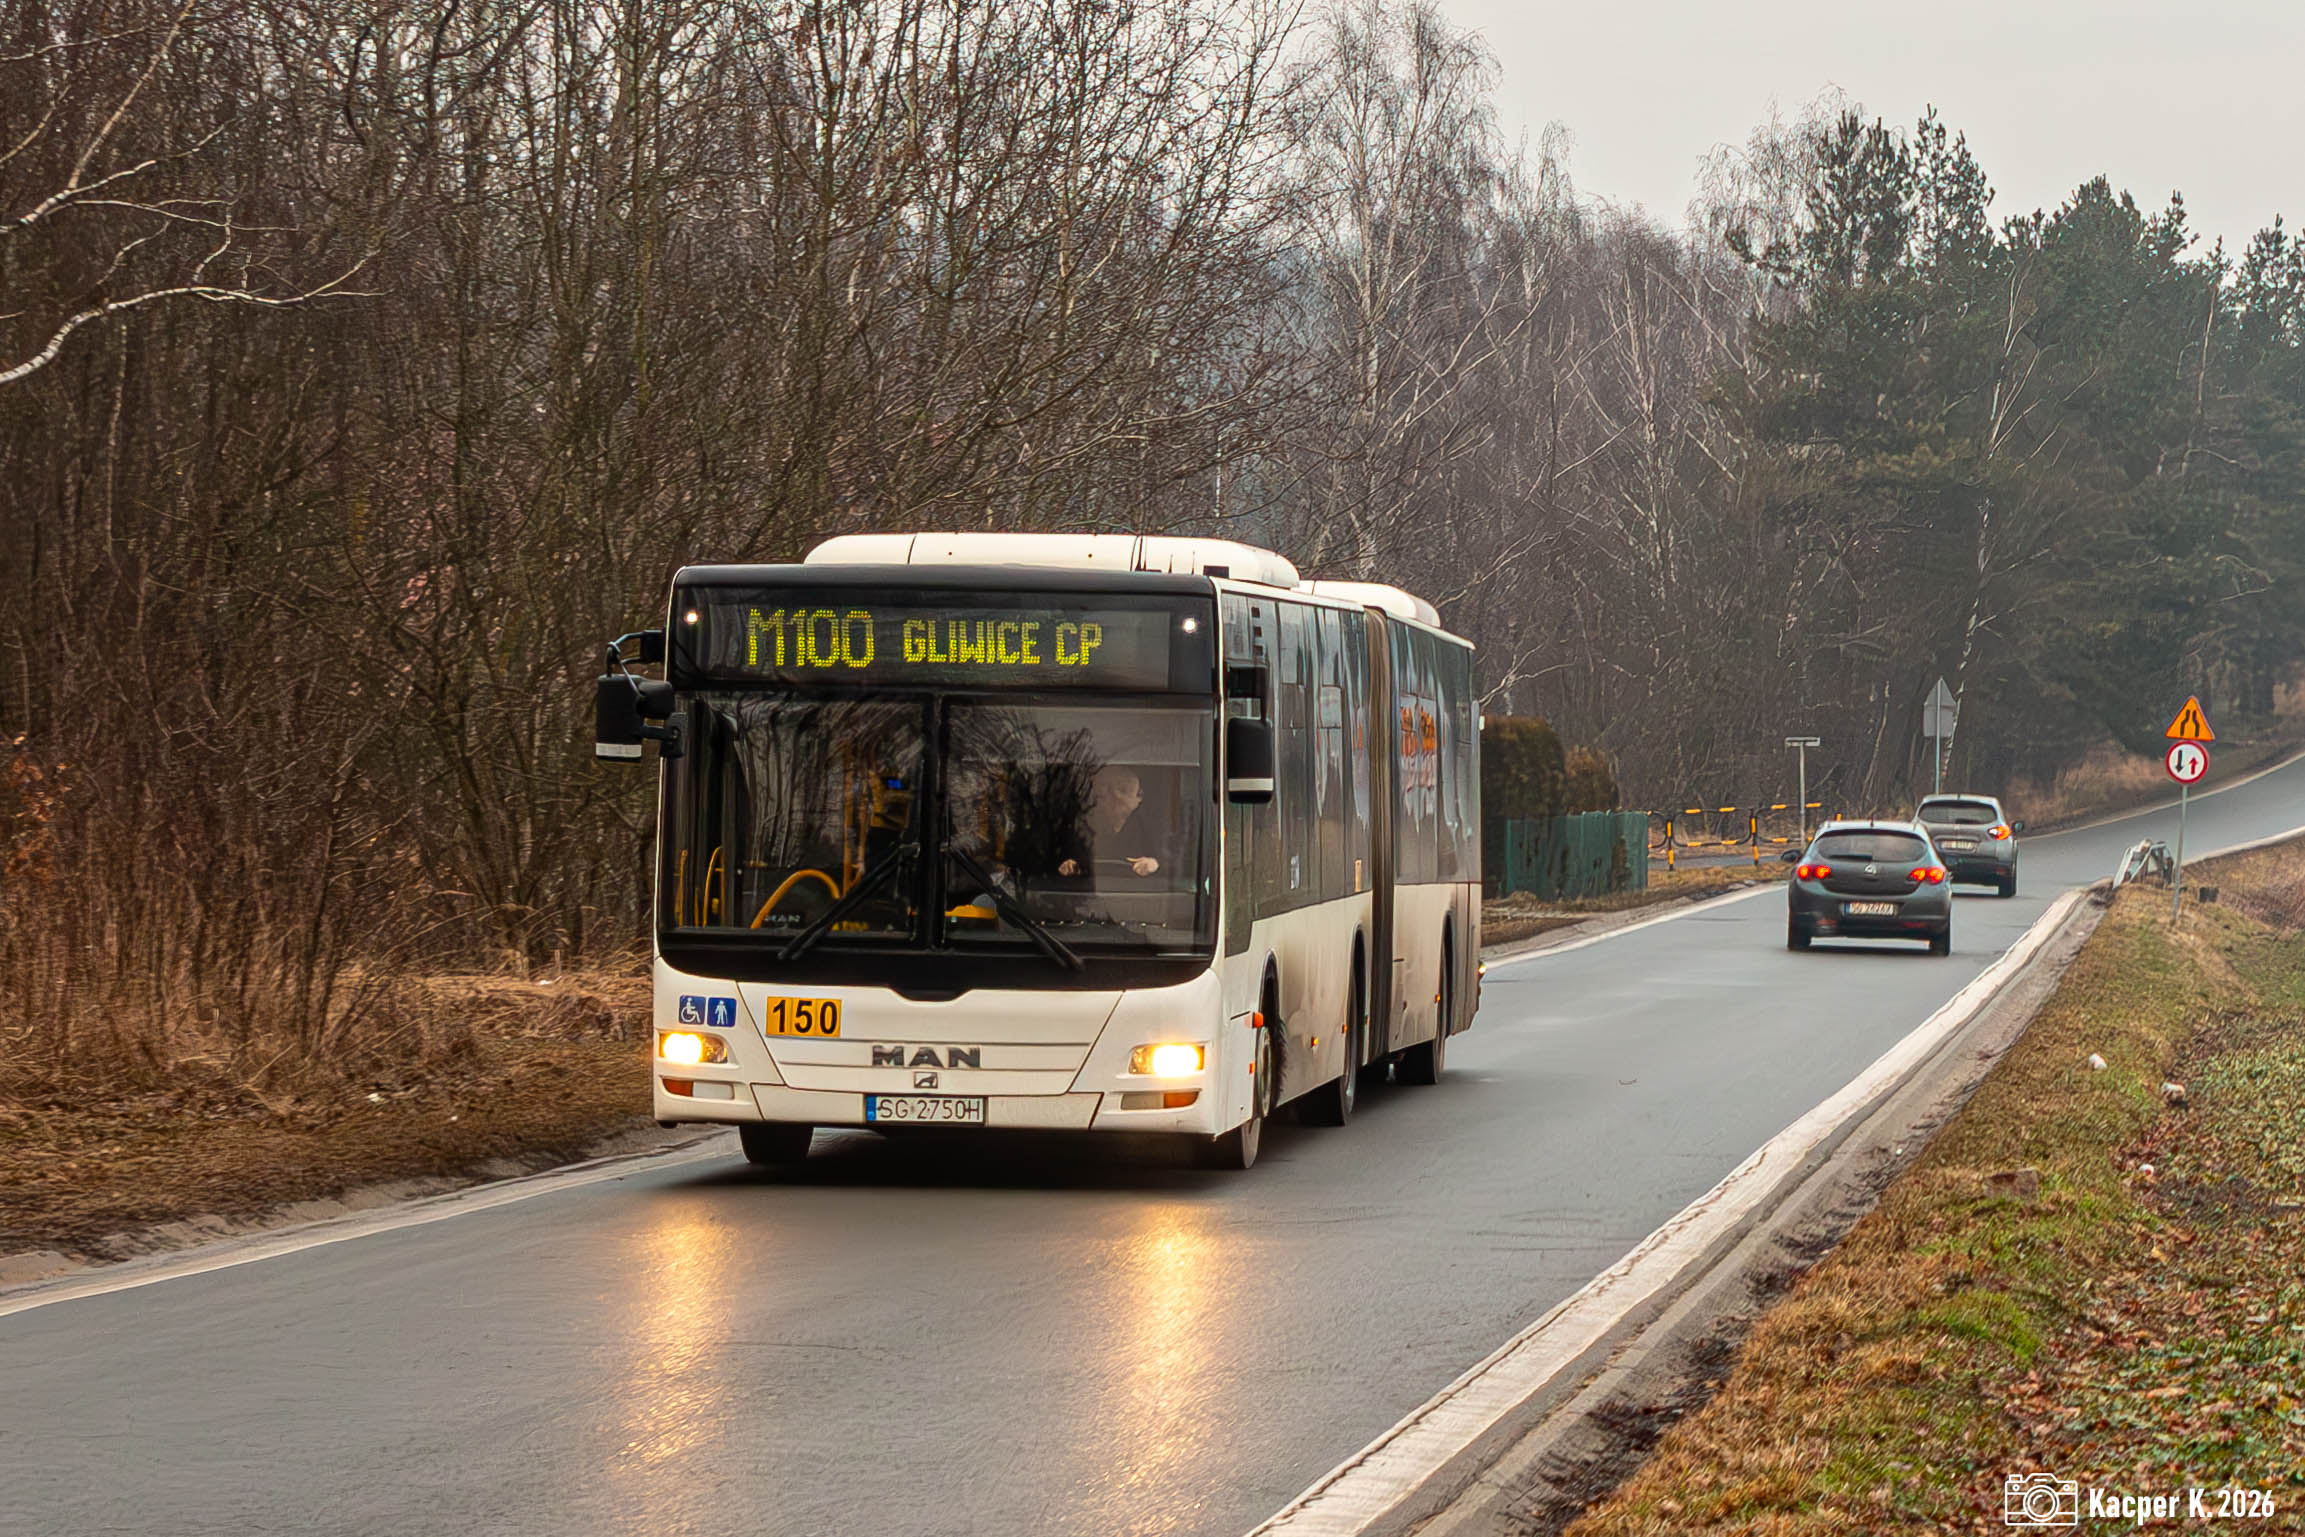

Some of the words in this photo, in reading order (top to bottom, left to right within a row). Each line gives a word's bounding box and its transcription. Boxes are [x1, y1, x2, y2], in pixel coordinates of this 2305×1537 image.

[748, 608, 875, 668] M100
[903, 618, 1041, 665] GLIWICE
[1055, 622, 1102, 666] CP
[772, 999, 838, 1034] 150
[872, 1045, 981, 1069] MAN
[879, 1098, 909, 1119] SG
[917, 1099, 980, 1120] 2750H
